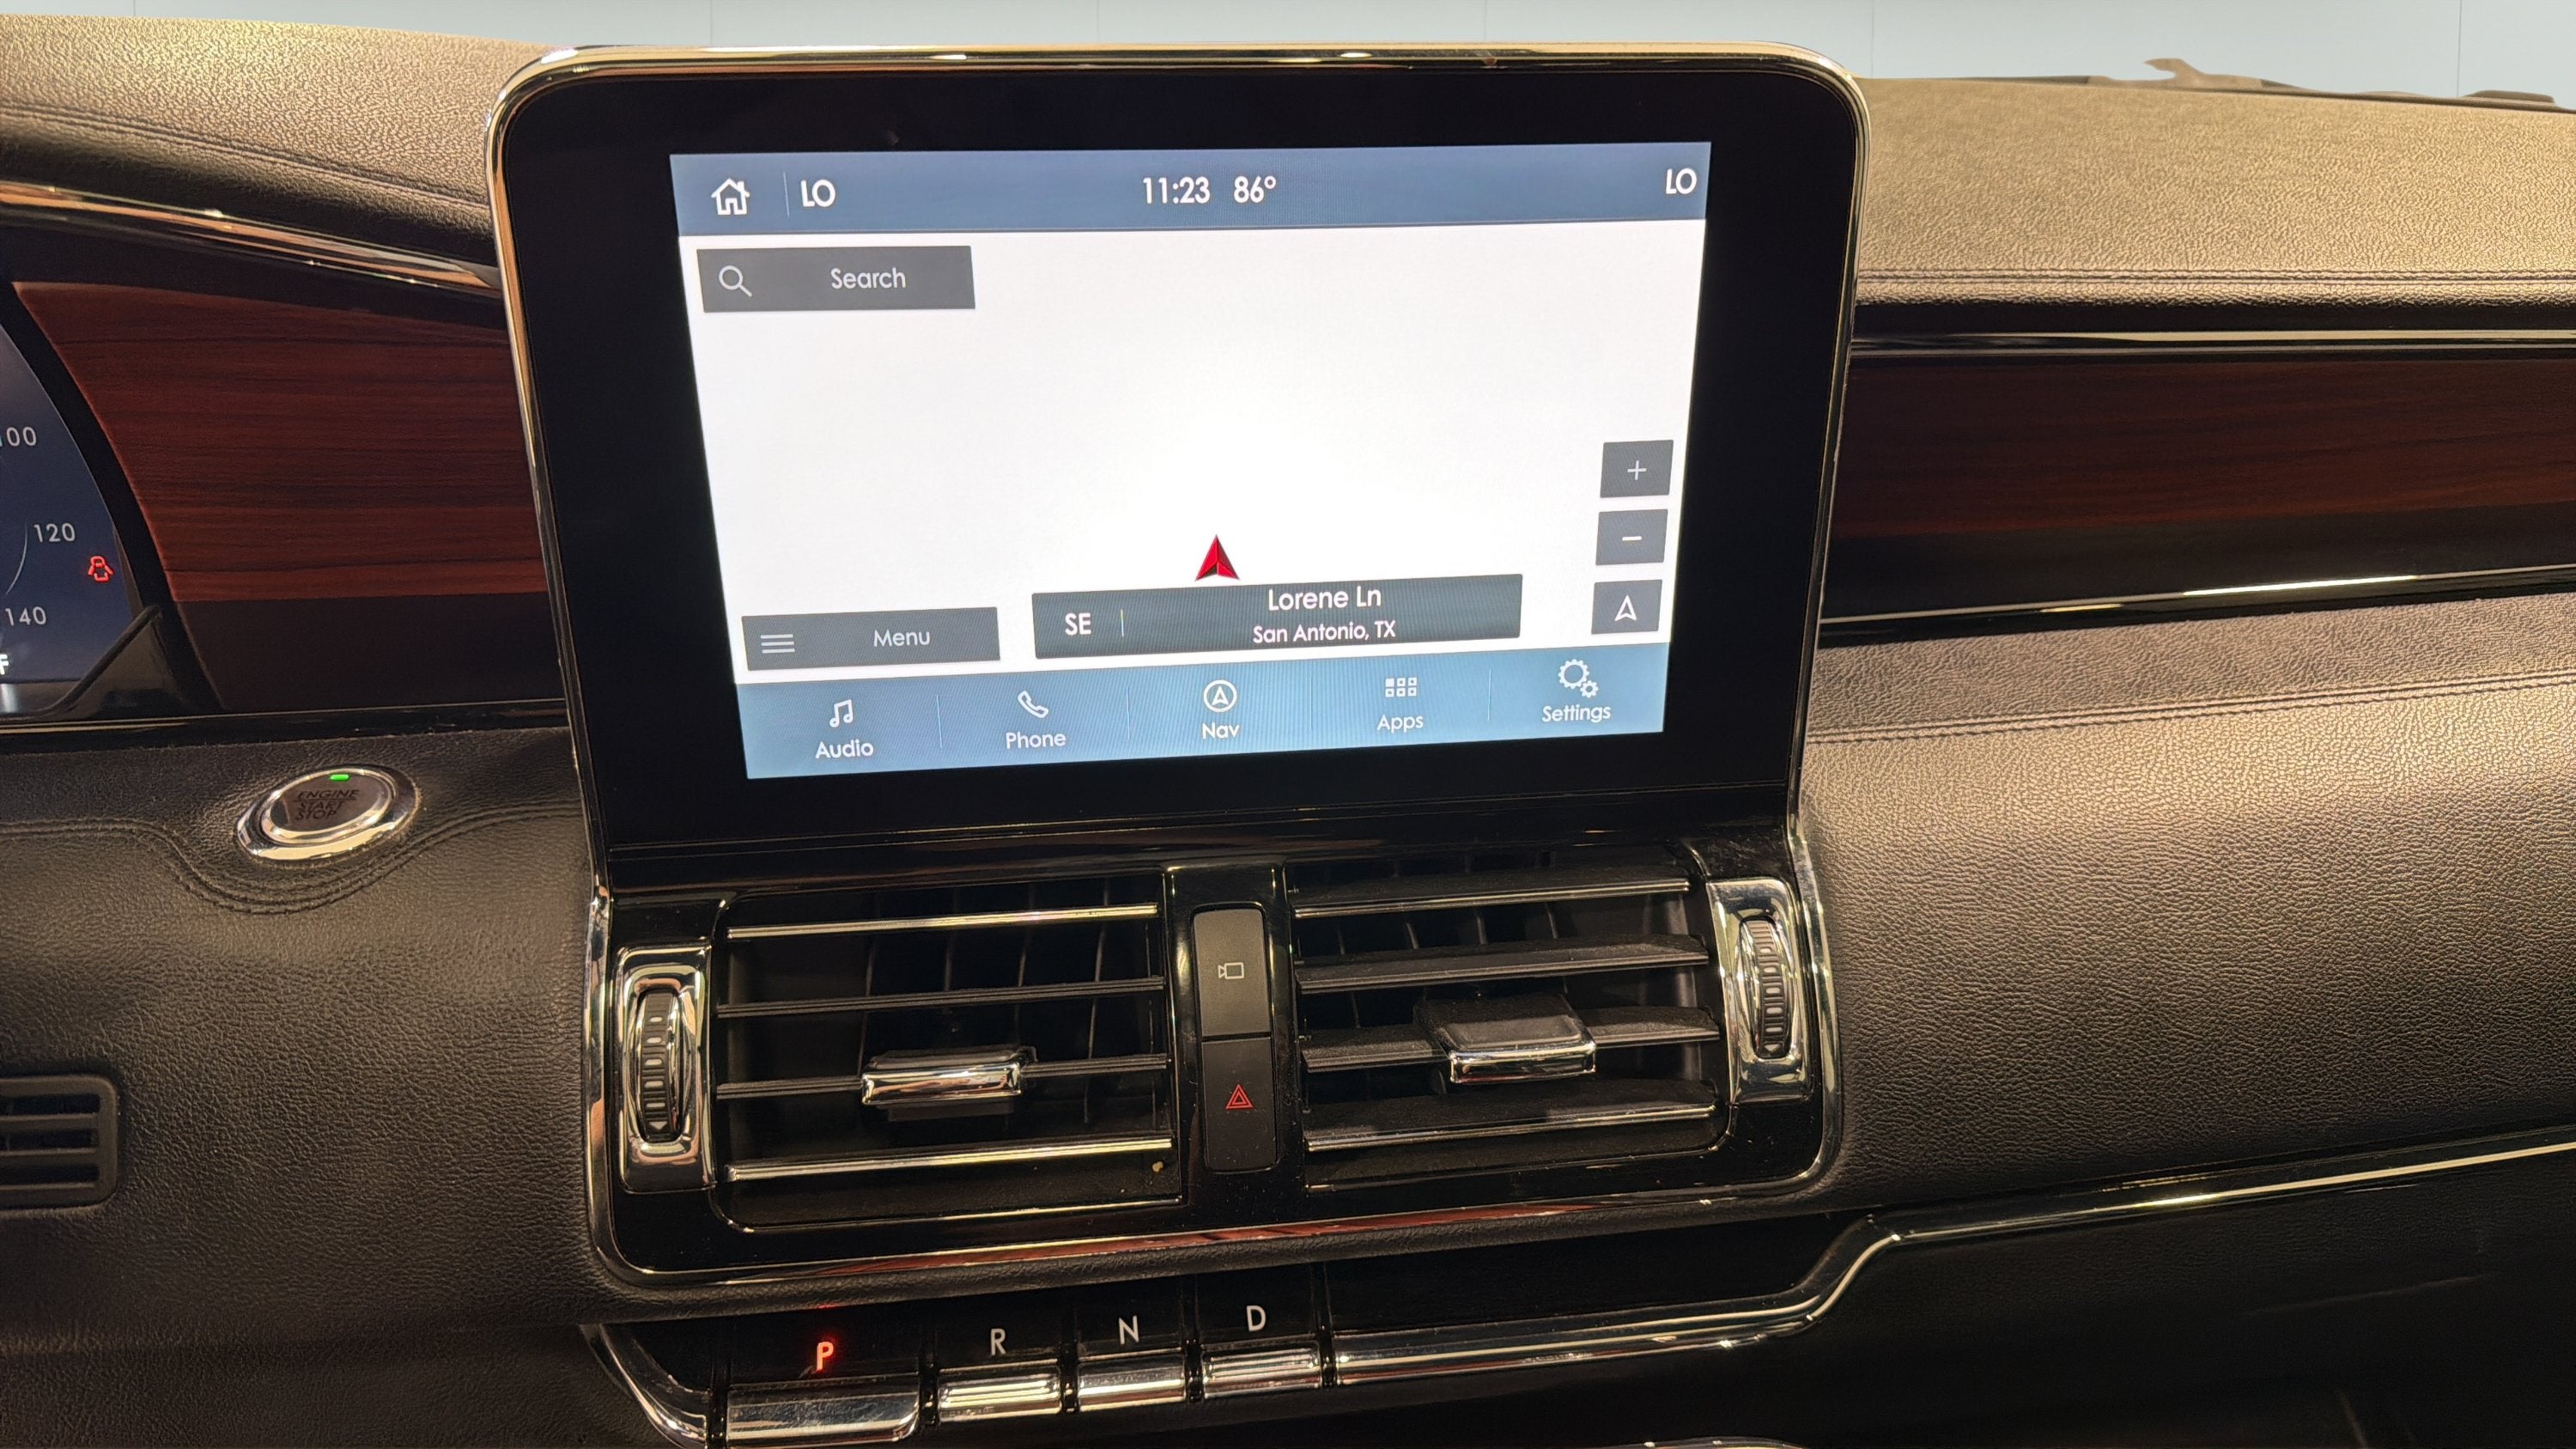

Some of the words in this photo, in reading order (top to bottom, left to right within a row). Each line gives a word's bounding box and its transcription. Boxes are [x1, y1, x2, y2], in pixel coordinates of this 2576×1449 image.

[1144, 177, 1210, 204] 11:23
[1666, 168, 1697, 194] LO
[801, 180, 835, 207] LO
[831, 268, 905, 289] Search
[0, 427, 36, 446] 00
[34, 523, 75, 542] 120
[1269, 589, 1348, 611] Lorene
[1357, 586, 1381, 606] Ln
[5, 606, 46, 625] 140
[1066, 613, 1091, 636] SE
[874, 630, 930, 647] Menu
[1254, 625, 1287, 643] San
[1293, 622, 1369, 642] Antonio,
[1375, 620, 1395, 637] TX
[1542, 704, 1611, 722] Settings
[1203, 722, 1239, 739] Nav
[1377, 715, 1423, 733] Apps
[816, 740, 873, 758] Audio
[1006, 732, 1066, 749] Phone
[297, 789, 359, 800] ENGINE
[295, 810, 337, 820] STOP
[298, 800, 343, 812] START
[1247, 1306, 1266, 1330] D
[1119, 1316, 1139, 1344] N
[991, 1329, 1005, 1355] R
[817, 1342, 834, 1371] P
